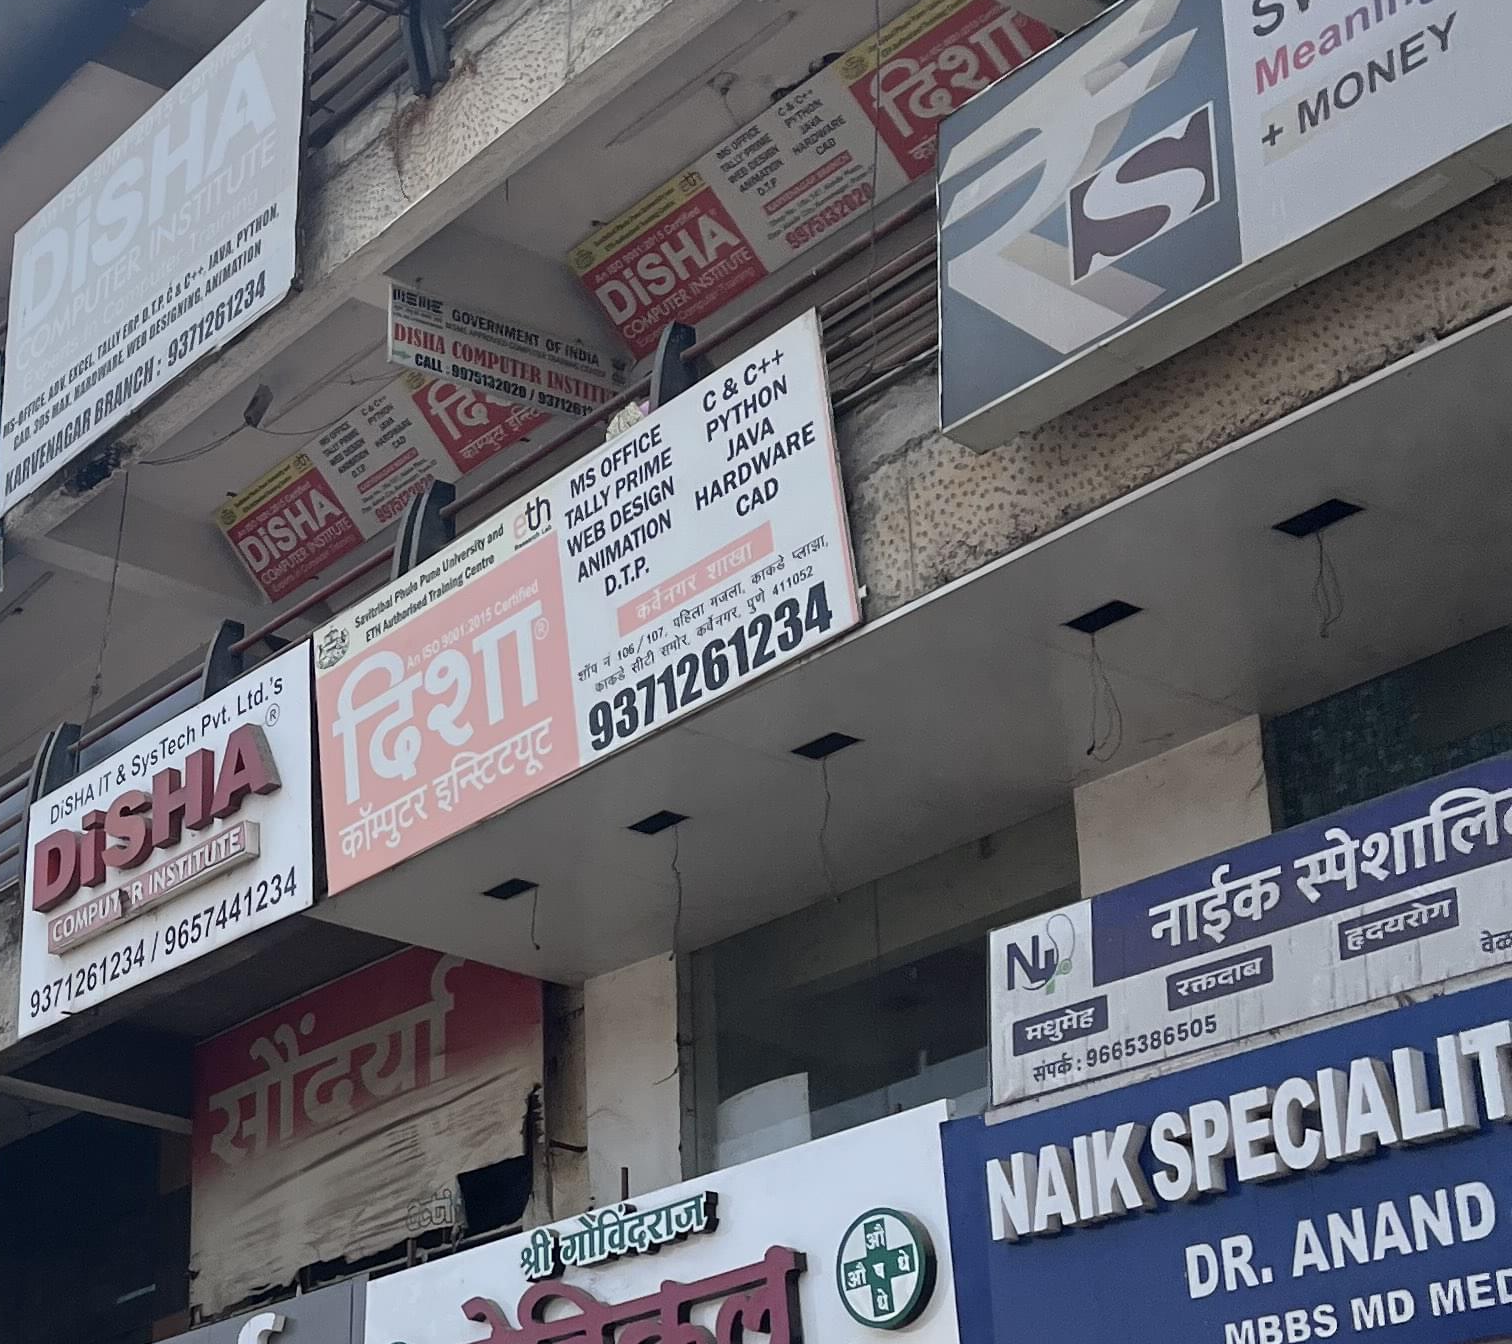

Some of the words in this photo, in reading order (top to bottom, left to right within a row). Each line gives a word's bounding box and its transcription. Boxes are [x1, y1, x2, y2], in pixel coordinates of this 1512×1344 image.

[869, 6, 1034, 139] दिशा
[1297, 10, 1457, 134] MONEY
[792, 115, 847, 156] HARDWARE
[126, 328, 148, 358] WEB
[205, 238, 263, 297] ANIMATION
[595, 213, 743, 327] DiSHA
[623, 288, 692, 340] COMPUTER
[691, 245, 754, 294] INSTITUTE
[97, 328, 120, 363] TALLY
[394, 322, 446, 355] DISHA
[451, 340, 542, 383] COMPUTER
[451, 308, 540, 348] GOVERNMENT
[546, 338, 561, 353] OF
[564, 343, 600, 368] INDIA
[4, 406, 92, 497] KARVENAGAR
[94, 354, 155, 427] BRANCH
[167, 269, 267, 368] 9371261234
[414, 353, 443, 374] CALL
[451, 363, 527, 399] 9975132020
[702, 390, 717, 413] C
[722, 377, 739, 401] &
[743, 349, 784, 387] C++
[705, 375, 788, 443] PYTHON
[570, 467, 597, 499] MS
[600, 424, 663, 478] OFFICE
[694, 421, 816, 511] HARDWARE
[726, 416, 775, 462] JAVA
[564, 485, 611, 530] TALLY
[615, 447, 673, 499] PRIME
[566, 519, 607, 557] WEB
[610, 475, 675, 533] DESIGN
[736, 477, 779, 517] CAD
[238, 486, 344, 574] DiSHA
[261, 542, 310, 586] COMPUTER
[309, 517, 354, 554] INSTITUTE
[442, 534, 487, 573] University
[487, 523, 505, 545] and
[577, 509, 672, 583] ANIMATION
[706, 540, 754, 581] शाखा
[382, 594, 429, 632] Authorised
[428, 577, 465, 609] Training
[464, 553, 496, 579] Centre
[494, 579, 540, 617] Certified
[605, 555, 650, 597] D.T.P.
[745, 588, 767, 616] पुणे
[772, 564, 815, 598] 411052
[672, 597, 706, 632] पहिला
[332, 599, 544, 806] दिशा
[588, 580, 834, 752] 9371261234
[49, 789, 96, 826] DiSHA
[97, 771, 112, 796] IT
[115, 763, 127, 785] &
[200, 705, 232, 738] Pvt.
[31, 721, 281, 914] DiSHA
[147, 826, 244, 896] INSTITUTE
[30, 943, 145, 1019] 9371261234
[164, 866, 299, 956] 9657441234
[1147, 863, 1283, 948] नाईक
[1173, 957, 1263, 1001] रक्तदाब
[1024, 1004, 1096, 1044] मधुमेह
[1086, 1014, 1218, 1068] 9665386505
[985, 1118, 1148, 1243] NAIK
[520, 1225, 554, 1283] श्री
[559, 1192, 710, 1270] गोविंदराज
[1183, 1233, 1275, 1300] DR.
[1291, 1179, 1498, 1279] ANAND
[1351, 1286, 1416, 1332] MD
